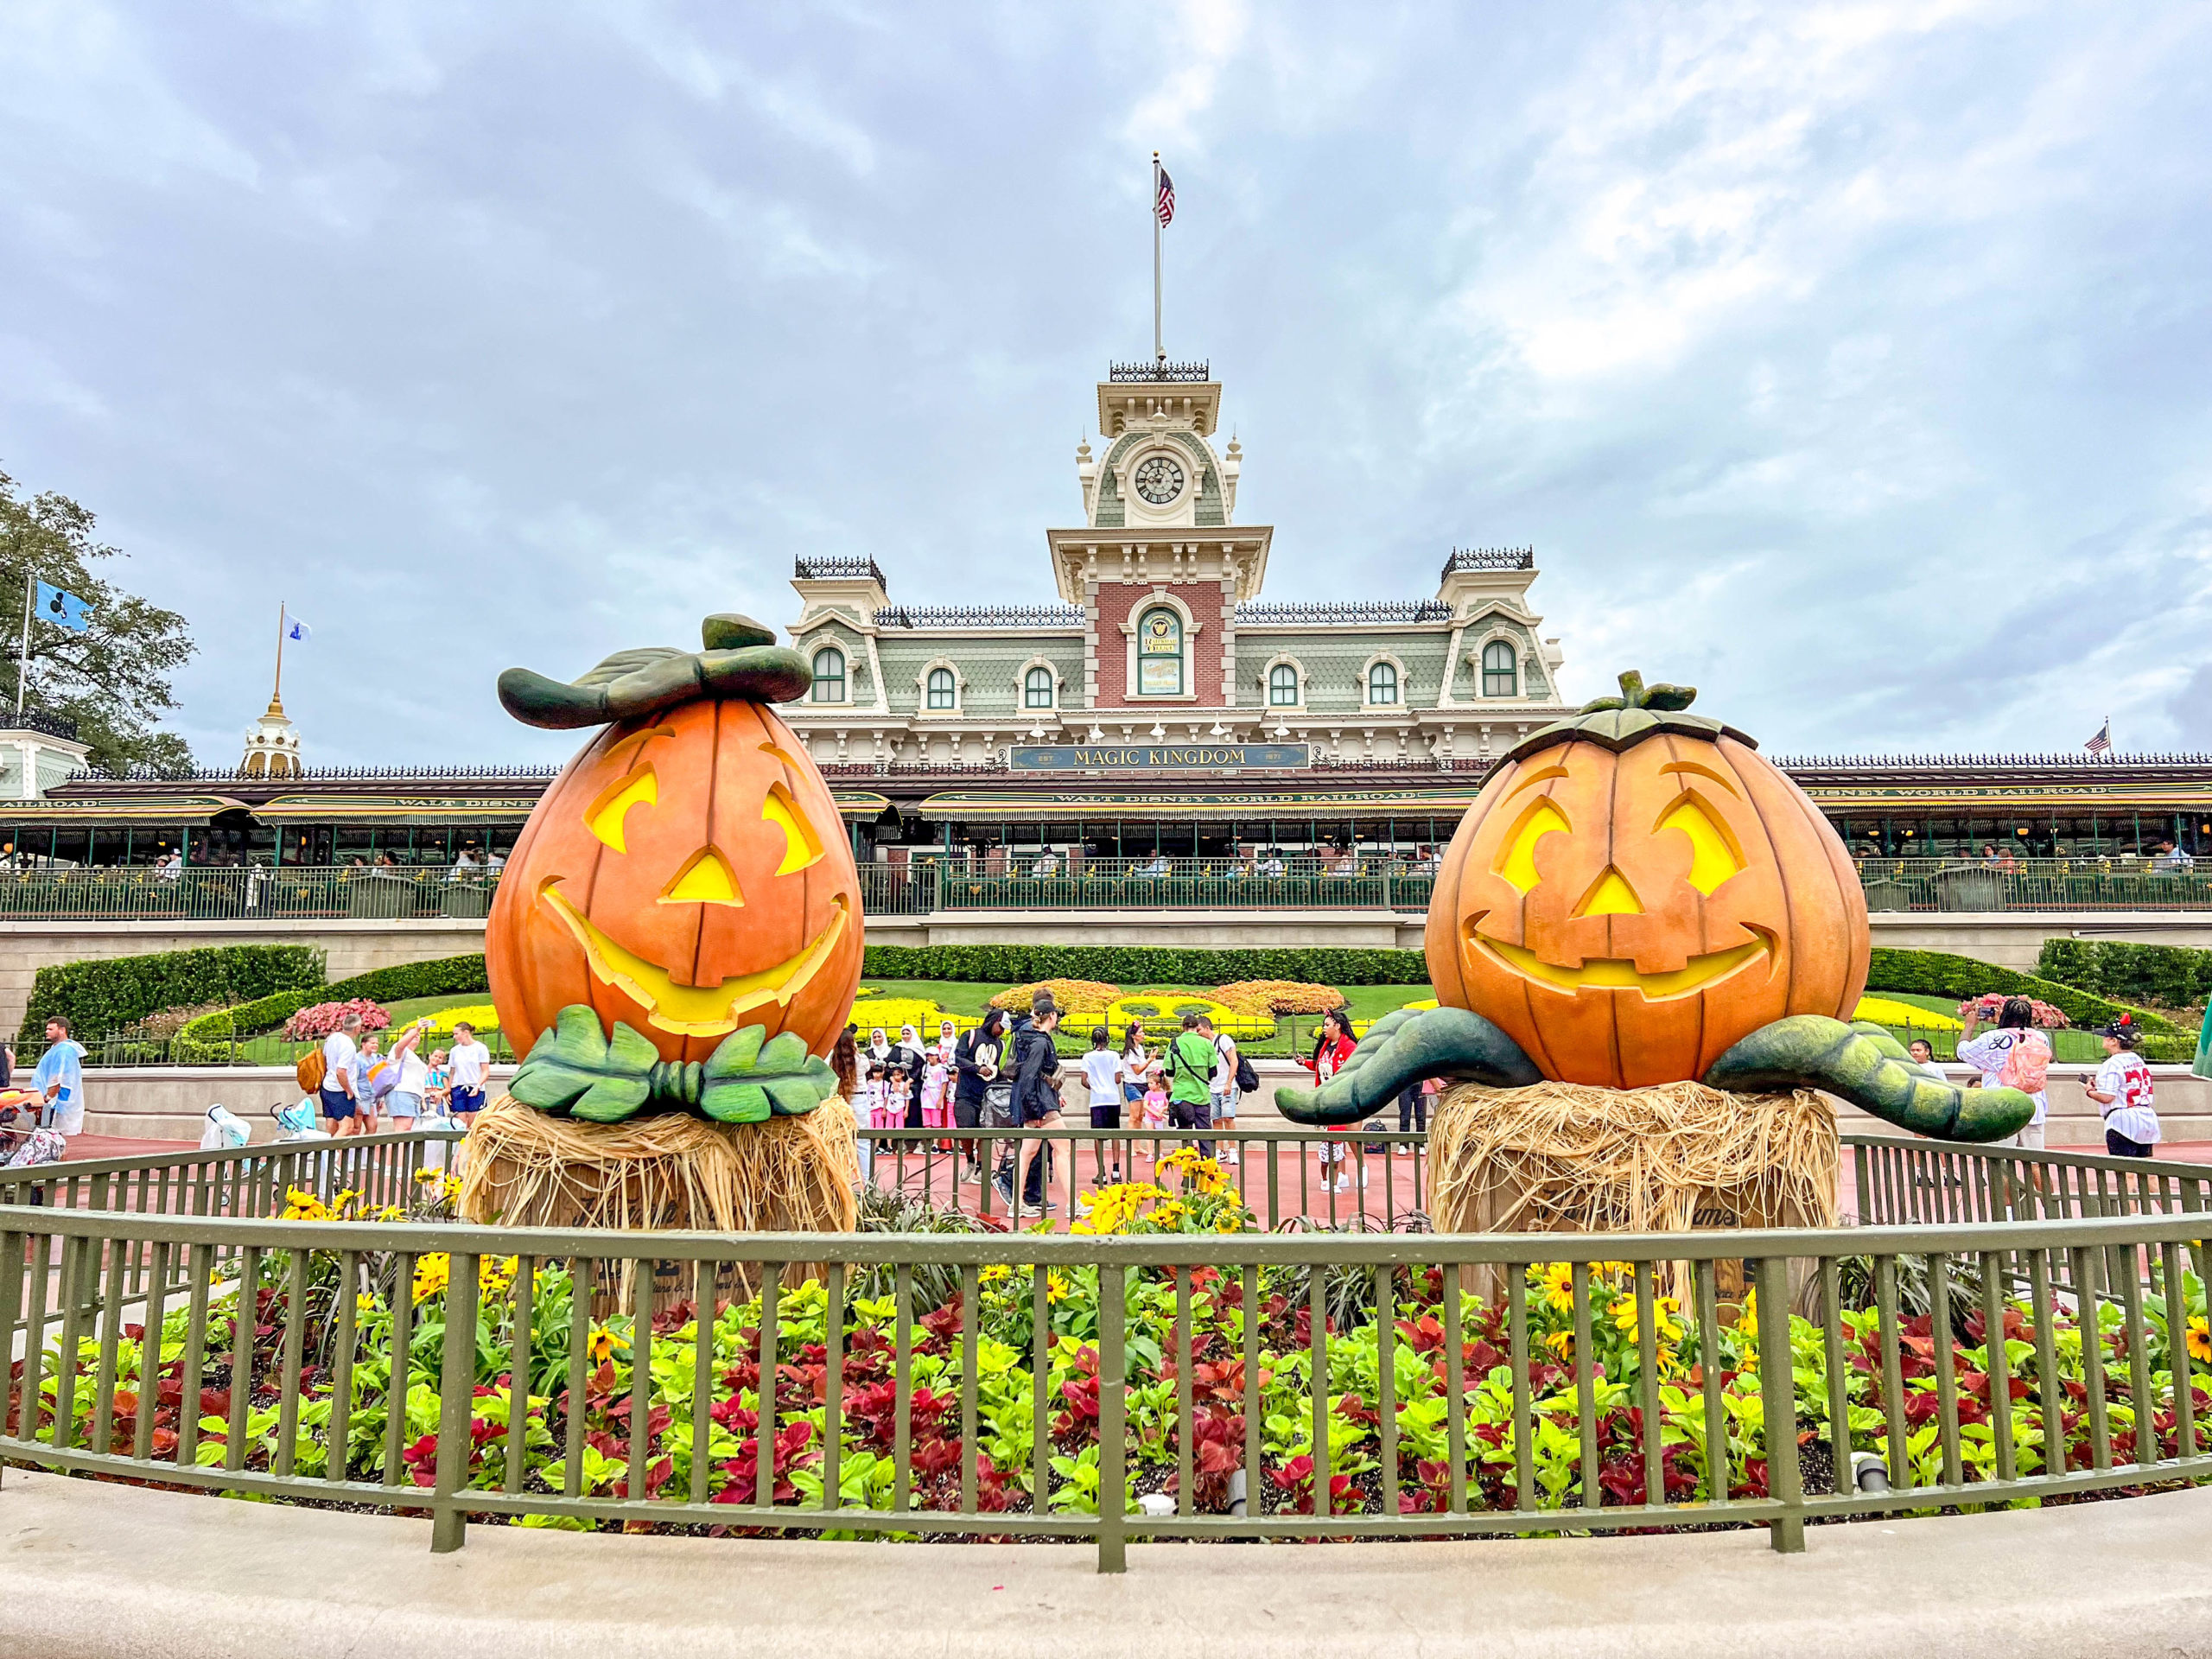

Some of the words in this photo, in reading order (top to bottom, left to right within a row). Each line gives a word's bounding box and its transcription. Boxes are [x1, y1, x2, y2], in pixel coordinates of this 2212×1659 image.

[1073, 750, 1140, 766] MAGIC
[1149, 749, 1246, 766] KINGDOM
[1986, 786, 2107, 795] RAILROAD
[1301, 791, 1416, 802] RAILROAD
